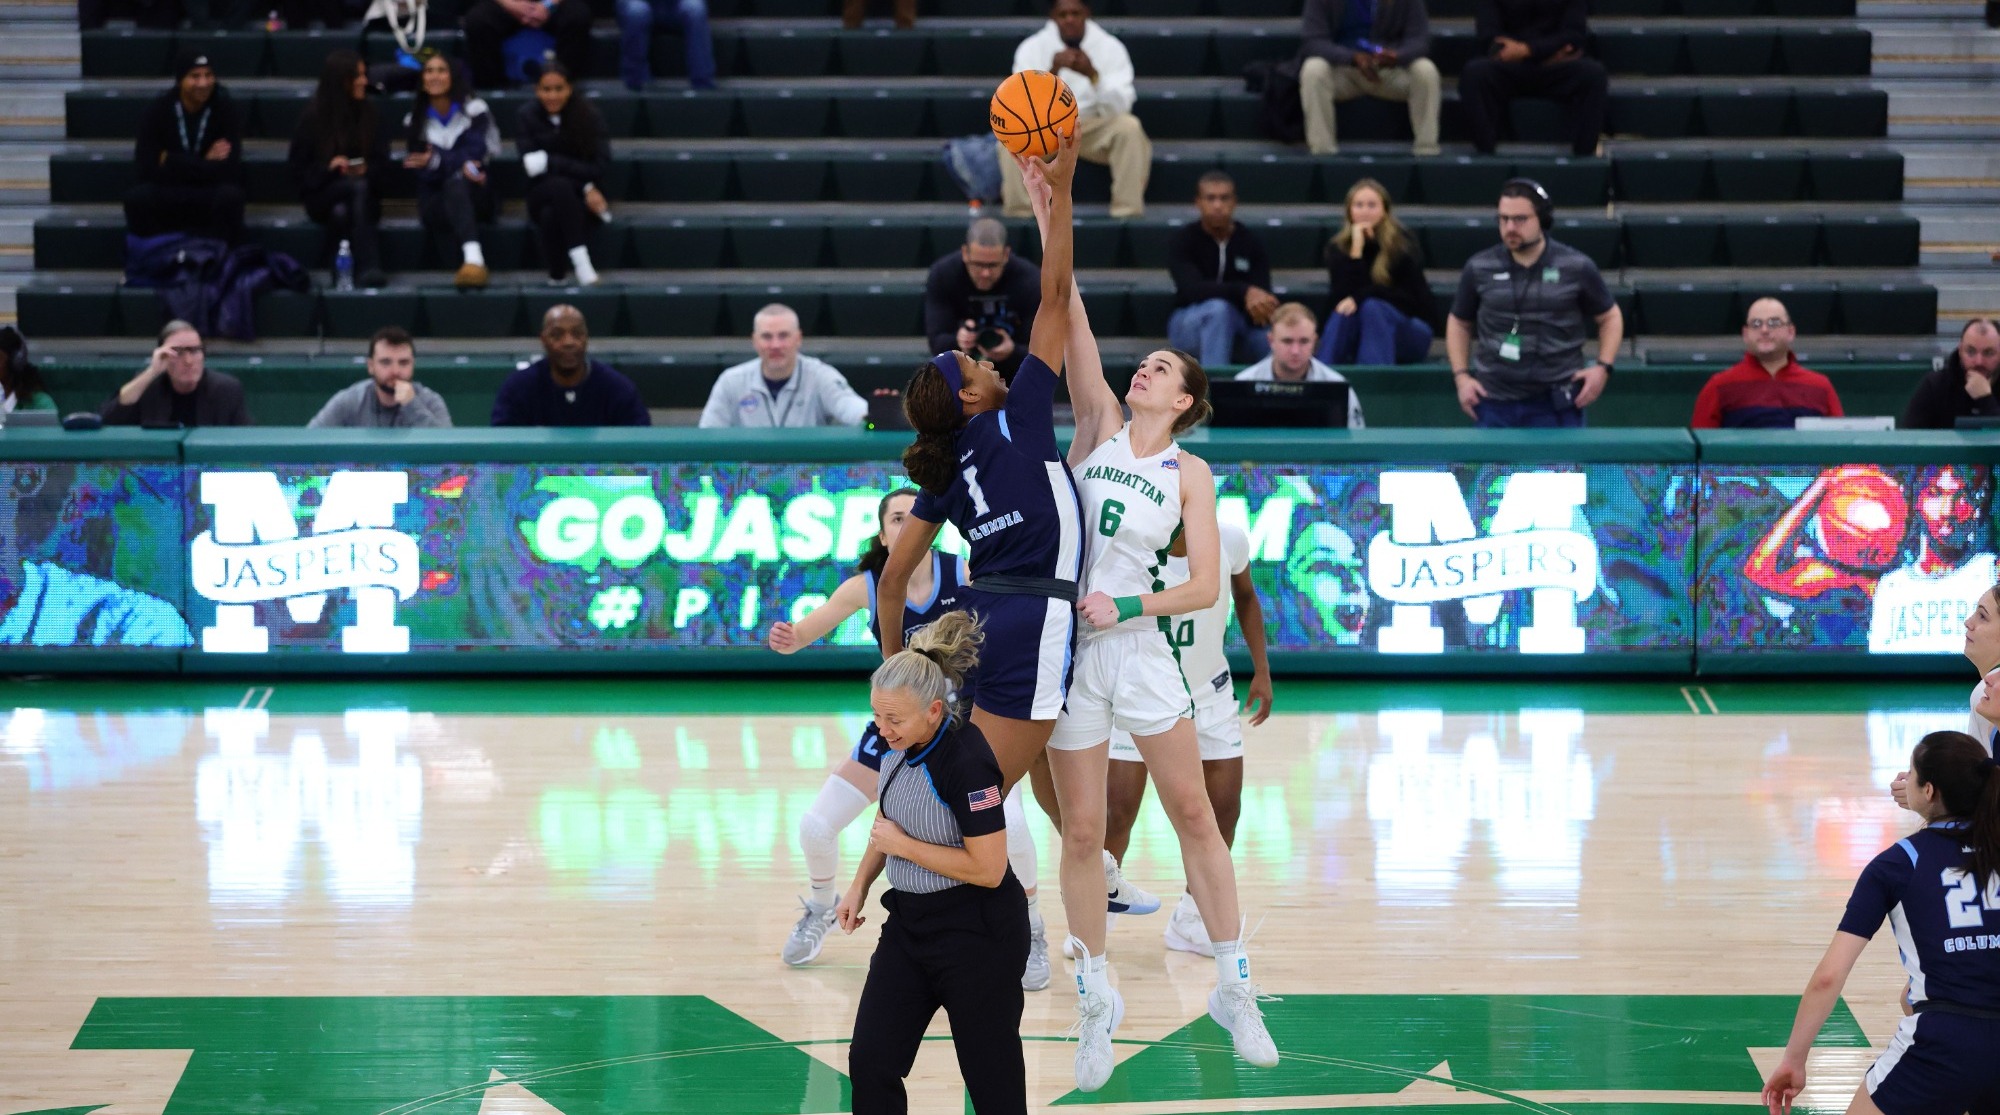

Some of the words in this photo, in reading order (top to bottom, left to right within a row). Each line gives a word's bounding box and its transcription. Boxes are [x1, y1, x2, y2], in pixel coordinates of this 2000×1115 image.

[962, 465, 991, 518] 1
[1083, 465, 1165, 507] MANHATTAN
[967, 510, 1024, 541] LUMBIA
[1099, 499, 1126, 538] 6
[201, 471, 410, 653] M
[213, 542, 399, 588] JASPERS
[1378, 472, 1587, 654] M
[1391, 543, 1577, 588] JASPERS
[1884, 599, 1978, 644] JASPER
[1944, 934, 2000, 953] COLUM
